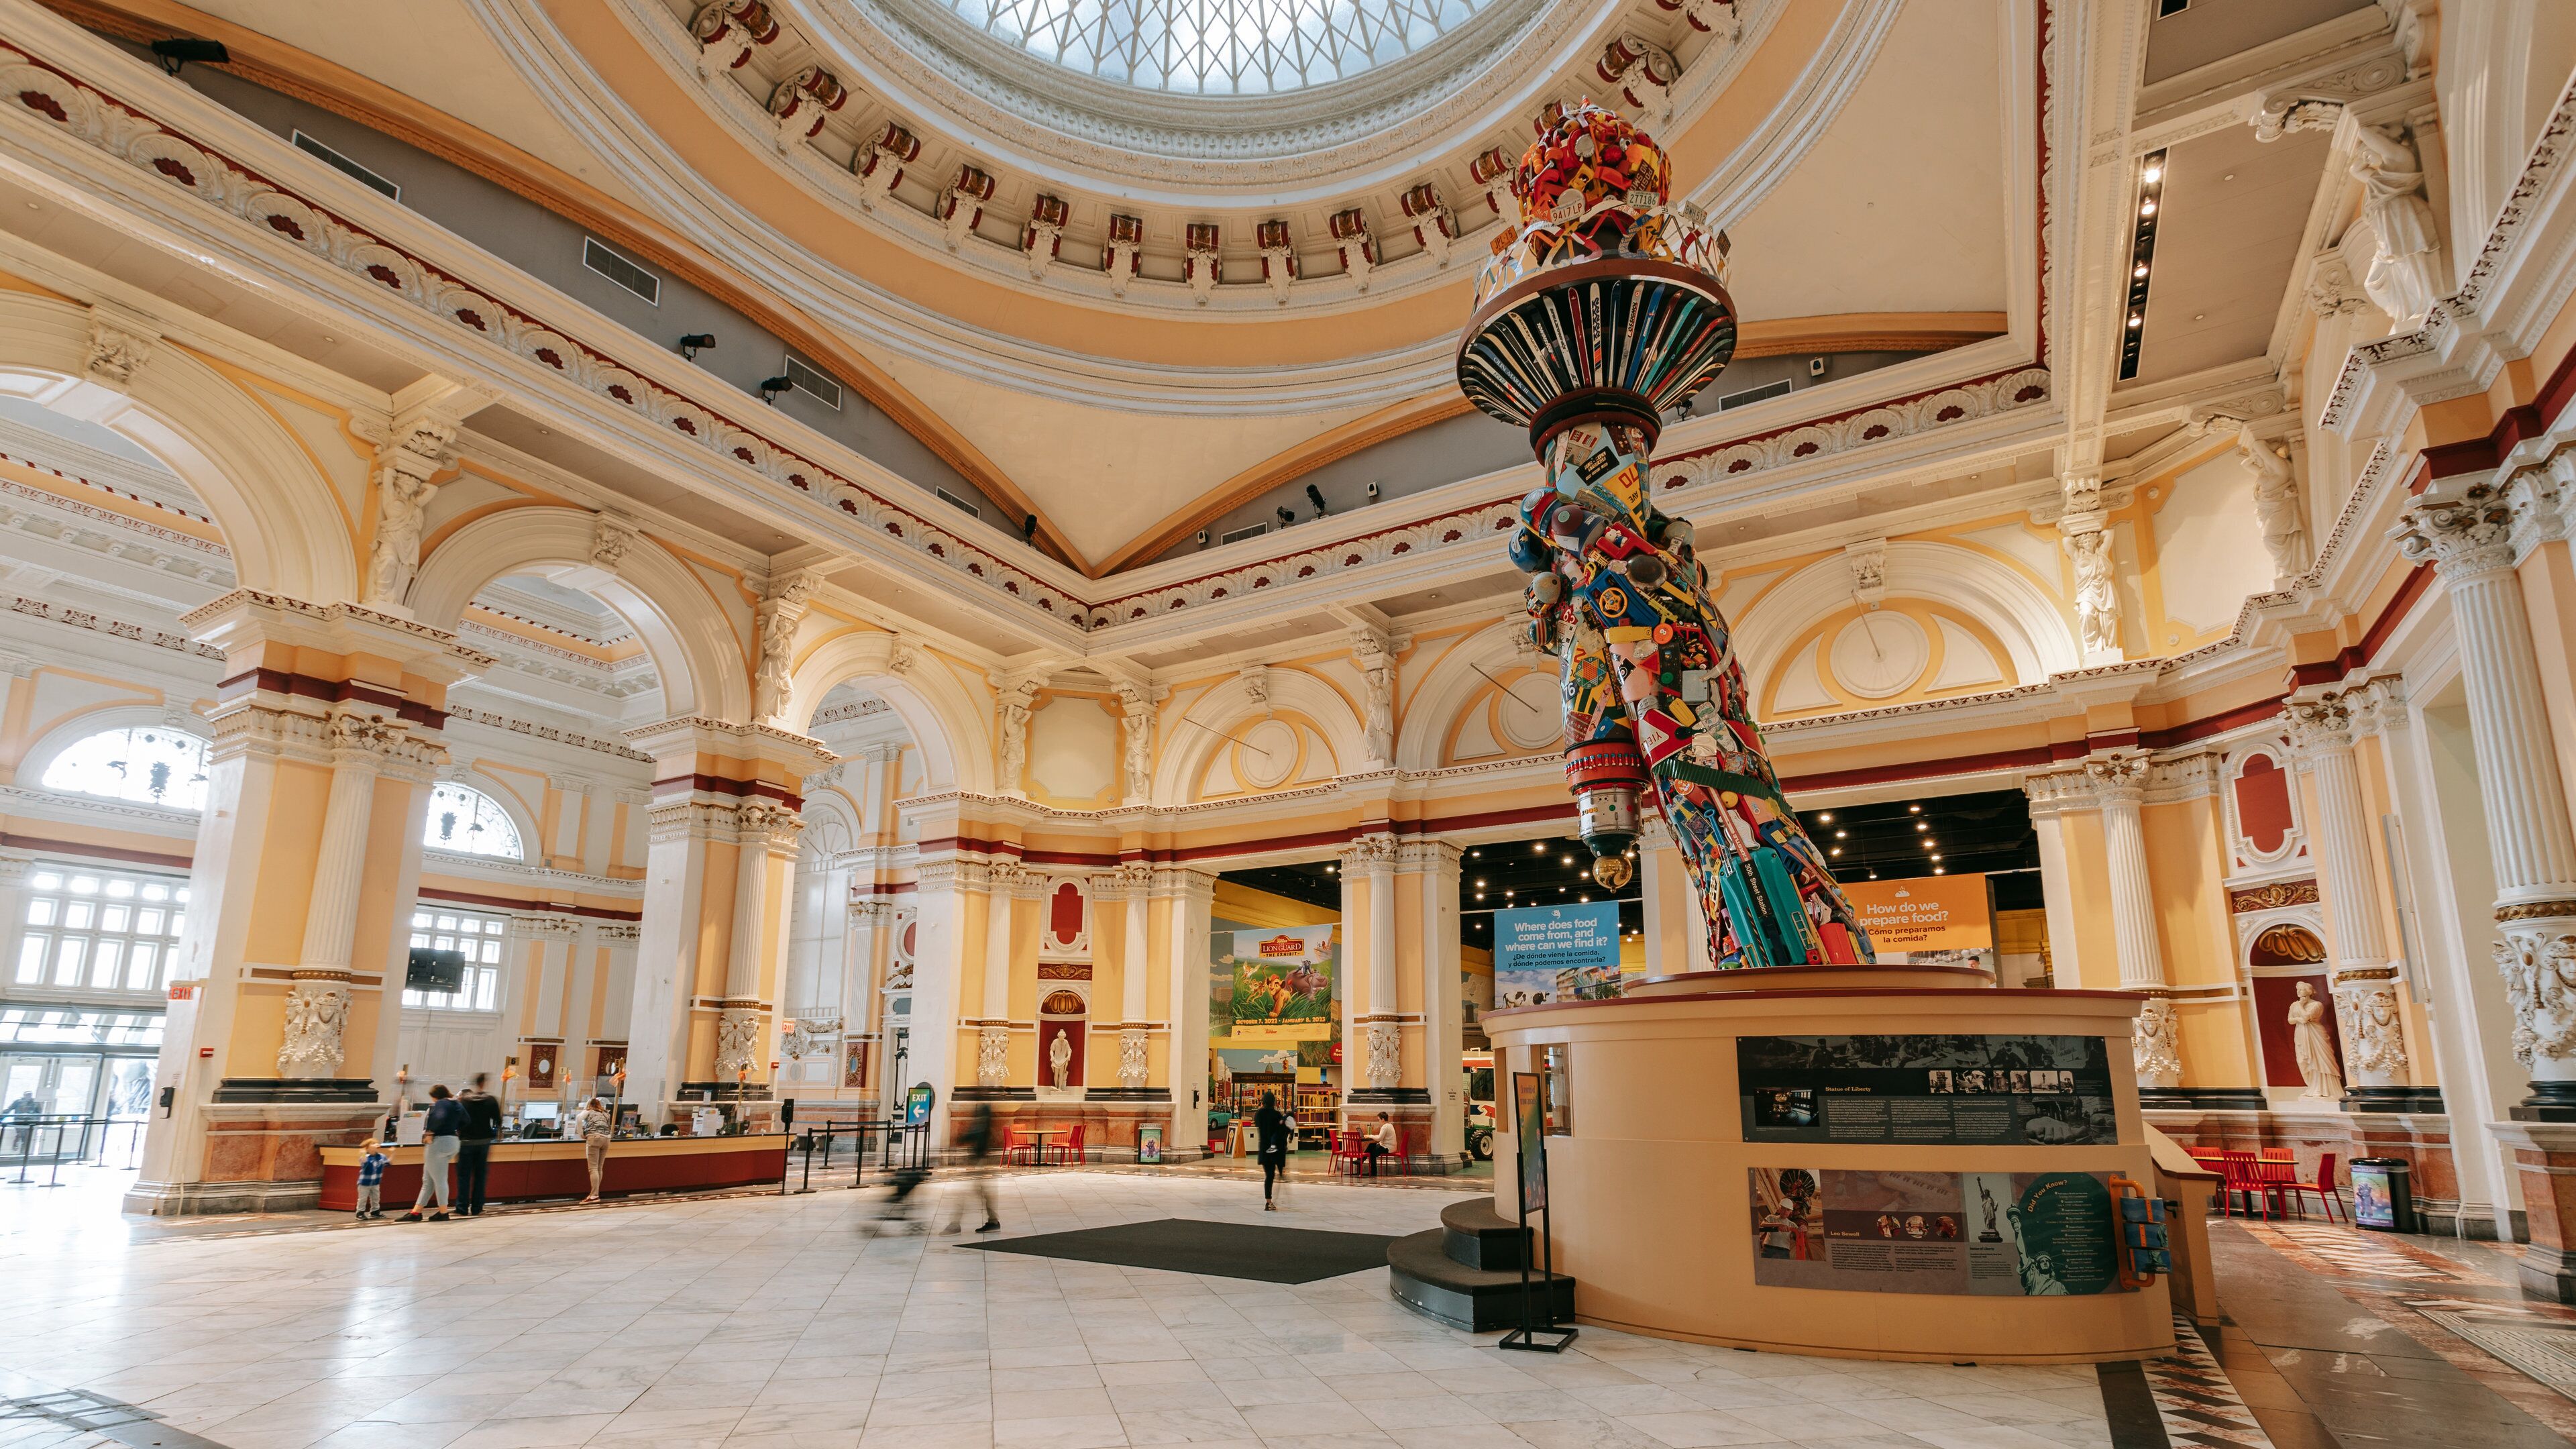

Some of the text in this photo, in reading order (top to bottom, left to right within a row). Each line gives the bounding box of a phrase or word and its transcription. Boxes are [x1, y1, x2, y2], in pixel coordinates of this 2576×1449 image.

[1629, 194, 1656, 205] 277186
[1553, 207, 1571, 221] 9417
[1573, 203, 1582, 214] LP
[1493, 357, 1507, 372] OLIN
[1505, 370, 1525, 389] MARK
[1641, 731, 1662, 752] YIELD
[1744, 863, 1768, 915] 30th Street Station
[1866, 902, 1939, 914] How do we
[1514, 918, 1597, 932] Where does food
[1860, 910, 1949, 927] prepare food?
[1518, 928, 1594, 942] come from, and
[1868, 925, 1945, 936] Cómo preparamos
[1505, 943, 1536, 951] where
[1538, 942, 1555, 950] can
[1574, 938, 1594, 948] find
[1596, 936, 1608, 947] it?
[1892, 934, 1927, 943] comida?
[1278, 943, 1301, 951] GUARD
[1535, 959, 1564, 967] podemos
[1566, 956, 1606, 965] encontrarla?
[171, 987, 193, 1000] EXIT
[912, 1093, 927, 1102] EXIT
[2027, 1179, 2068, 1213] Did You Know?
